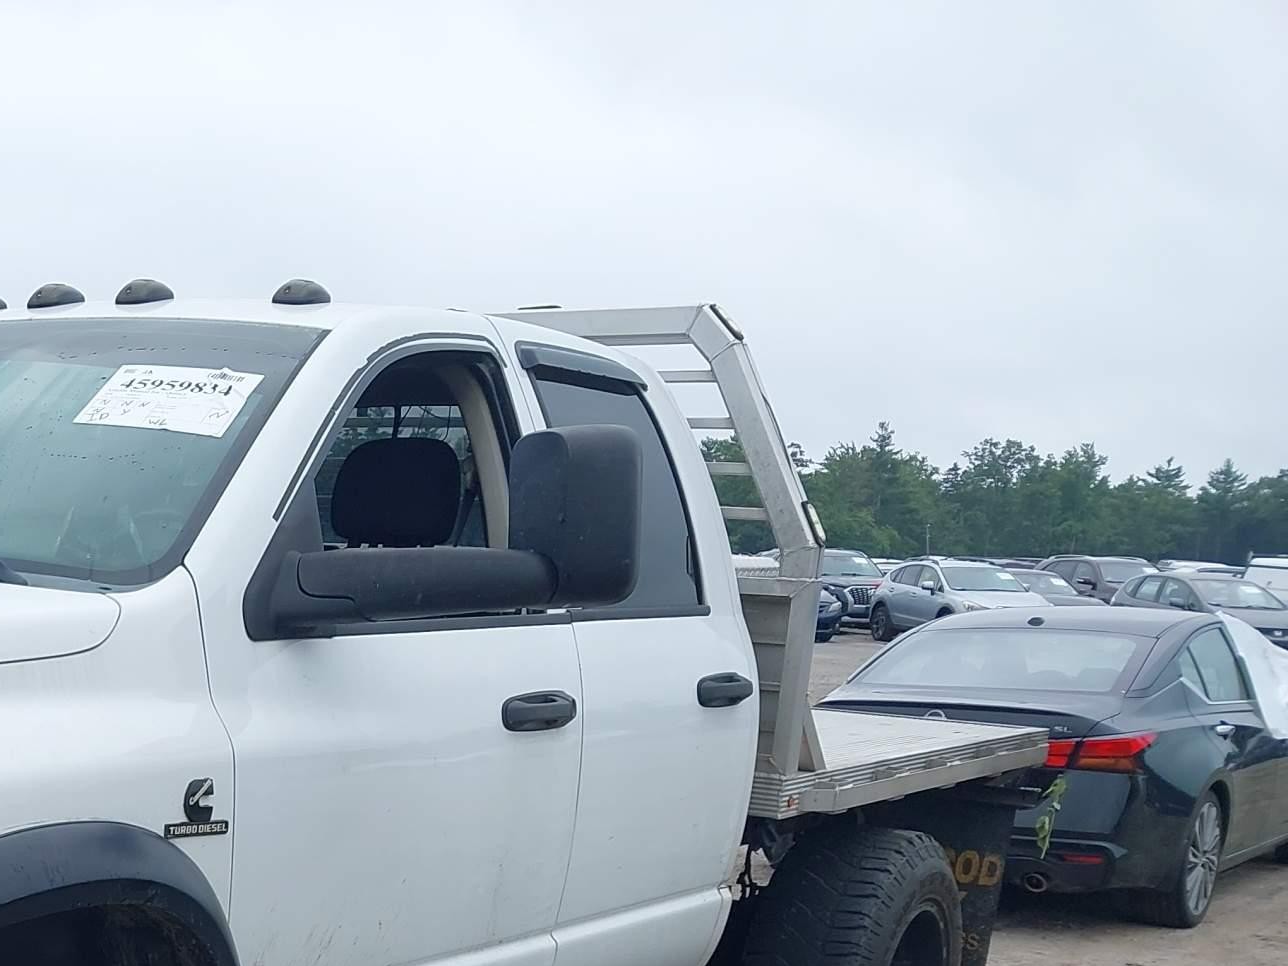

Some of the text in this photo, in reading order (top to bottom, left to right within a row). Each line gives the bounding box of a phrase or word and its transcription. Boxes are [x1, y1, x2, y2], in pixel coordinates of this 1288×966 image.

[120, 377, 233, 397] 45959834
[1052, 725, 1073, 734] SL
[168, 823, 227, 835] TURBO DIESEL
